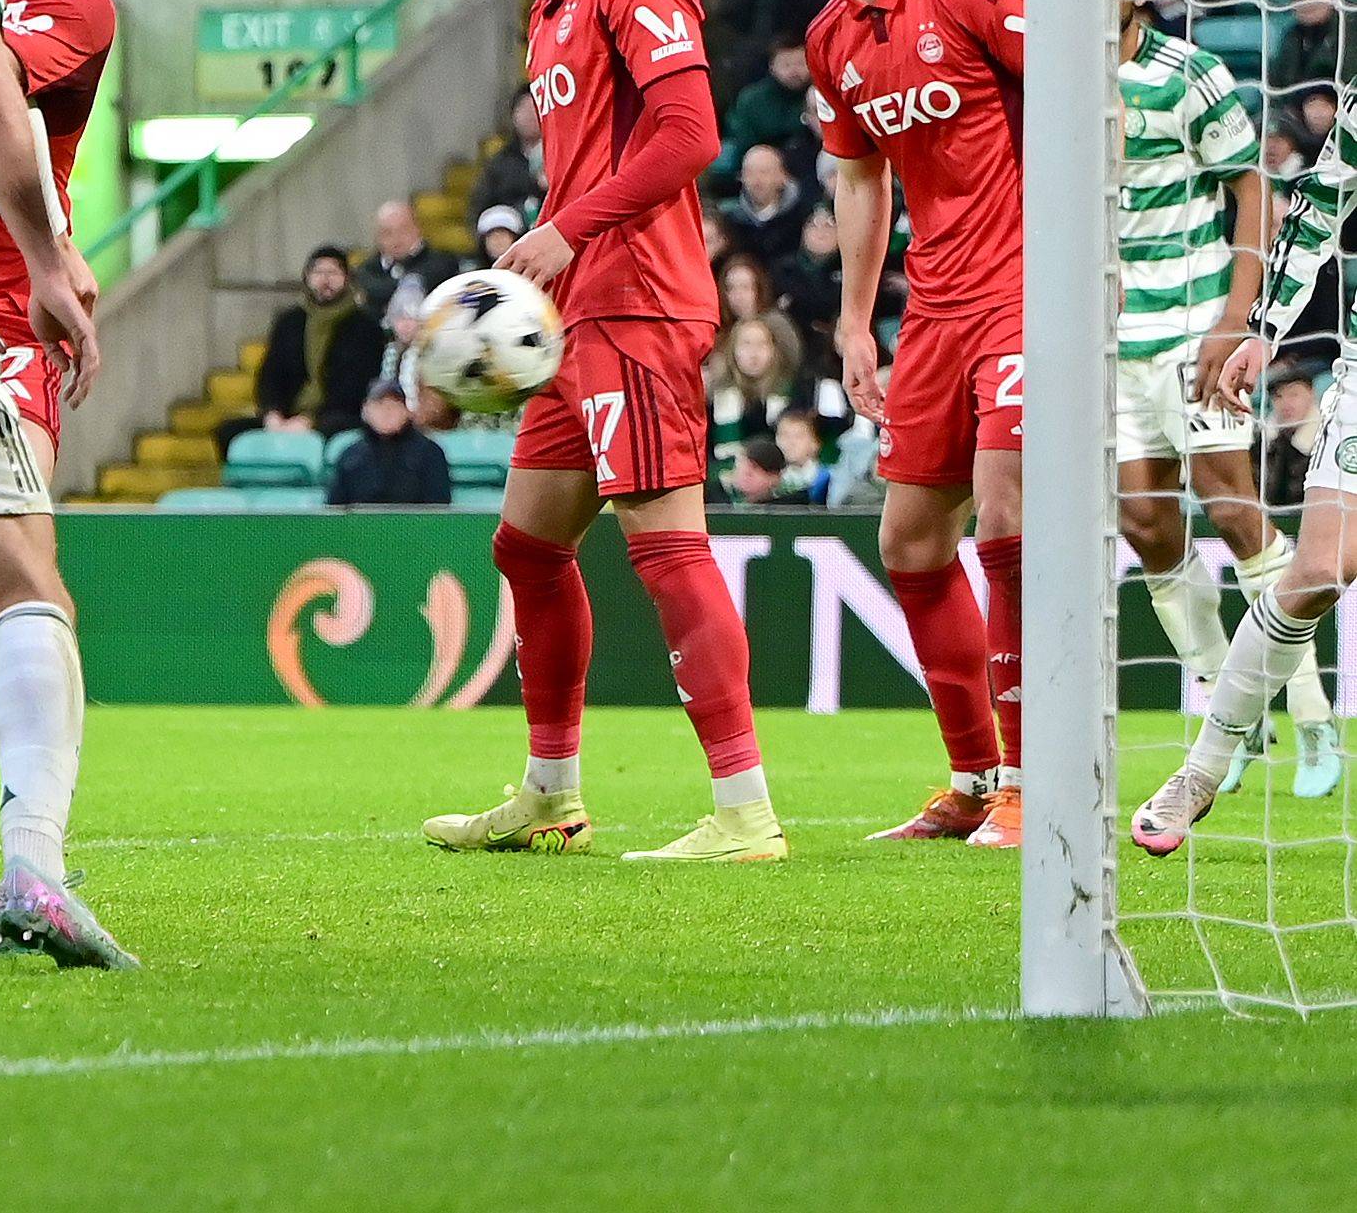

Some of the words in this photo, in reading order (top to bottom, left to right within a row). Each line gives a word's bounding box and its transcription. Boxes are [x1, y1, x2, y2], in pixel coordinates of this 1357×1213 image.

[221, 12, 291, 50] EXIT
[995, 354, 1025, 408] 2
[581, 390, 626, 457] 27
